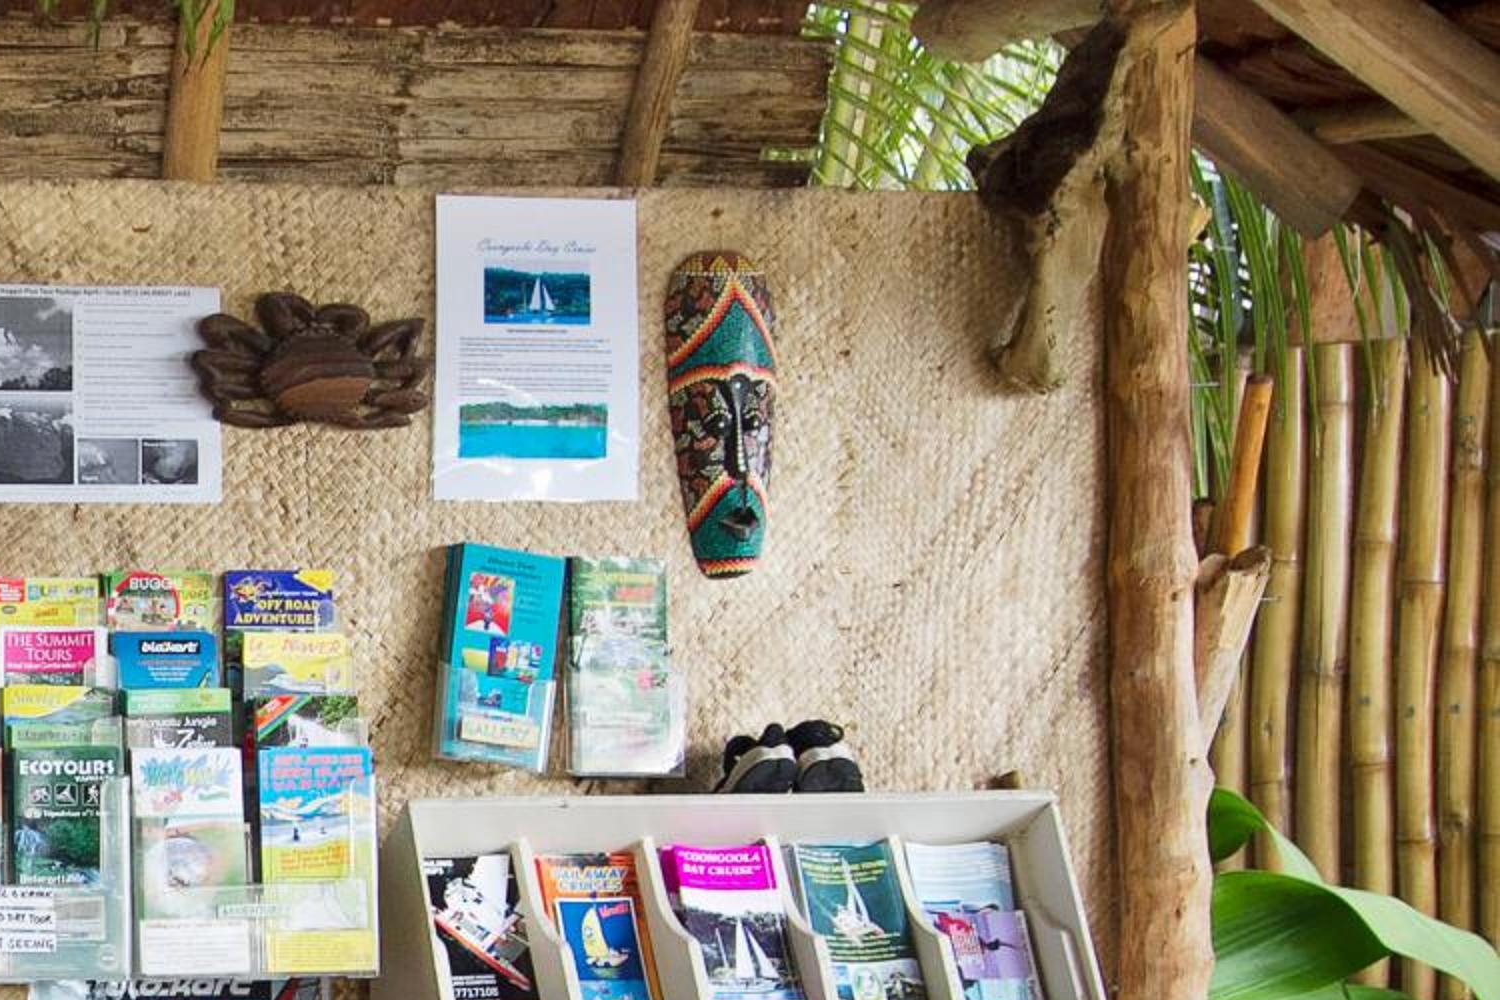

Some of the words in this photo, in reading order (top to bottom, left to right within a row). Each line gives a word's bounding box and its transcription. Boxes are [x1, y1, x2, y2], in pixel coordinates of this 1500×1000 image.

[257, 599, 283, 611] OFF
[233, 612, 322, 626] ADVENTURES
[6, 632, 34, 647] THE
[35, 632, 93, 648] SUMMIT
[25, 647, 74, 661] TOURS
[18, 759, 116, 776] ECOTOURS
